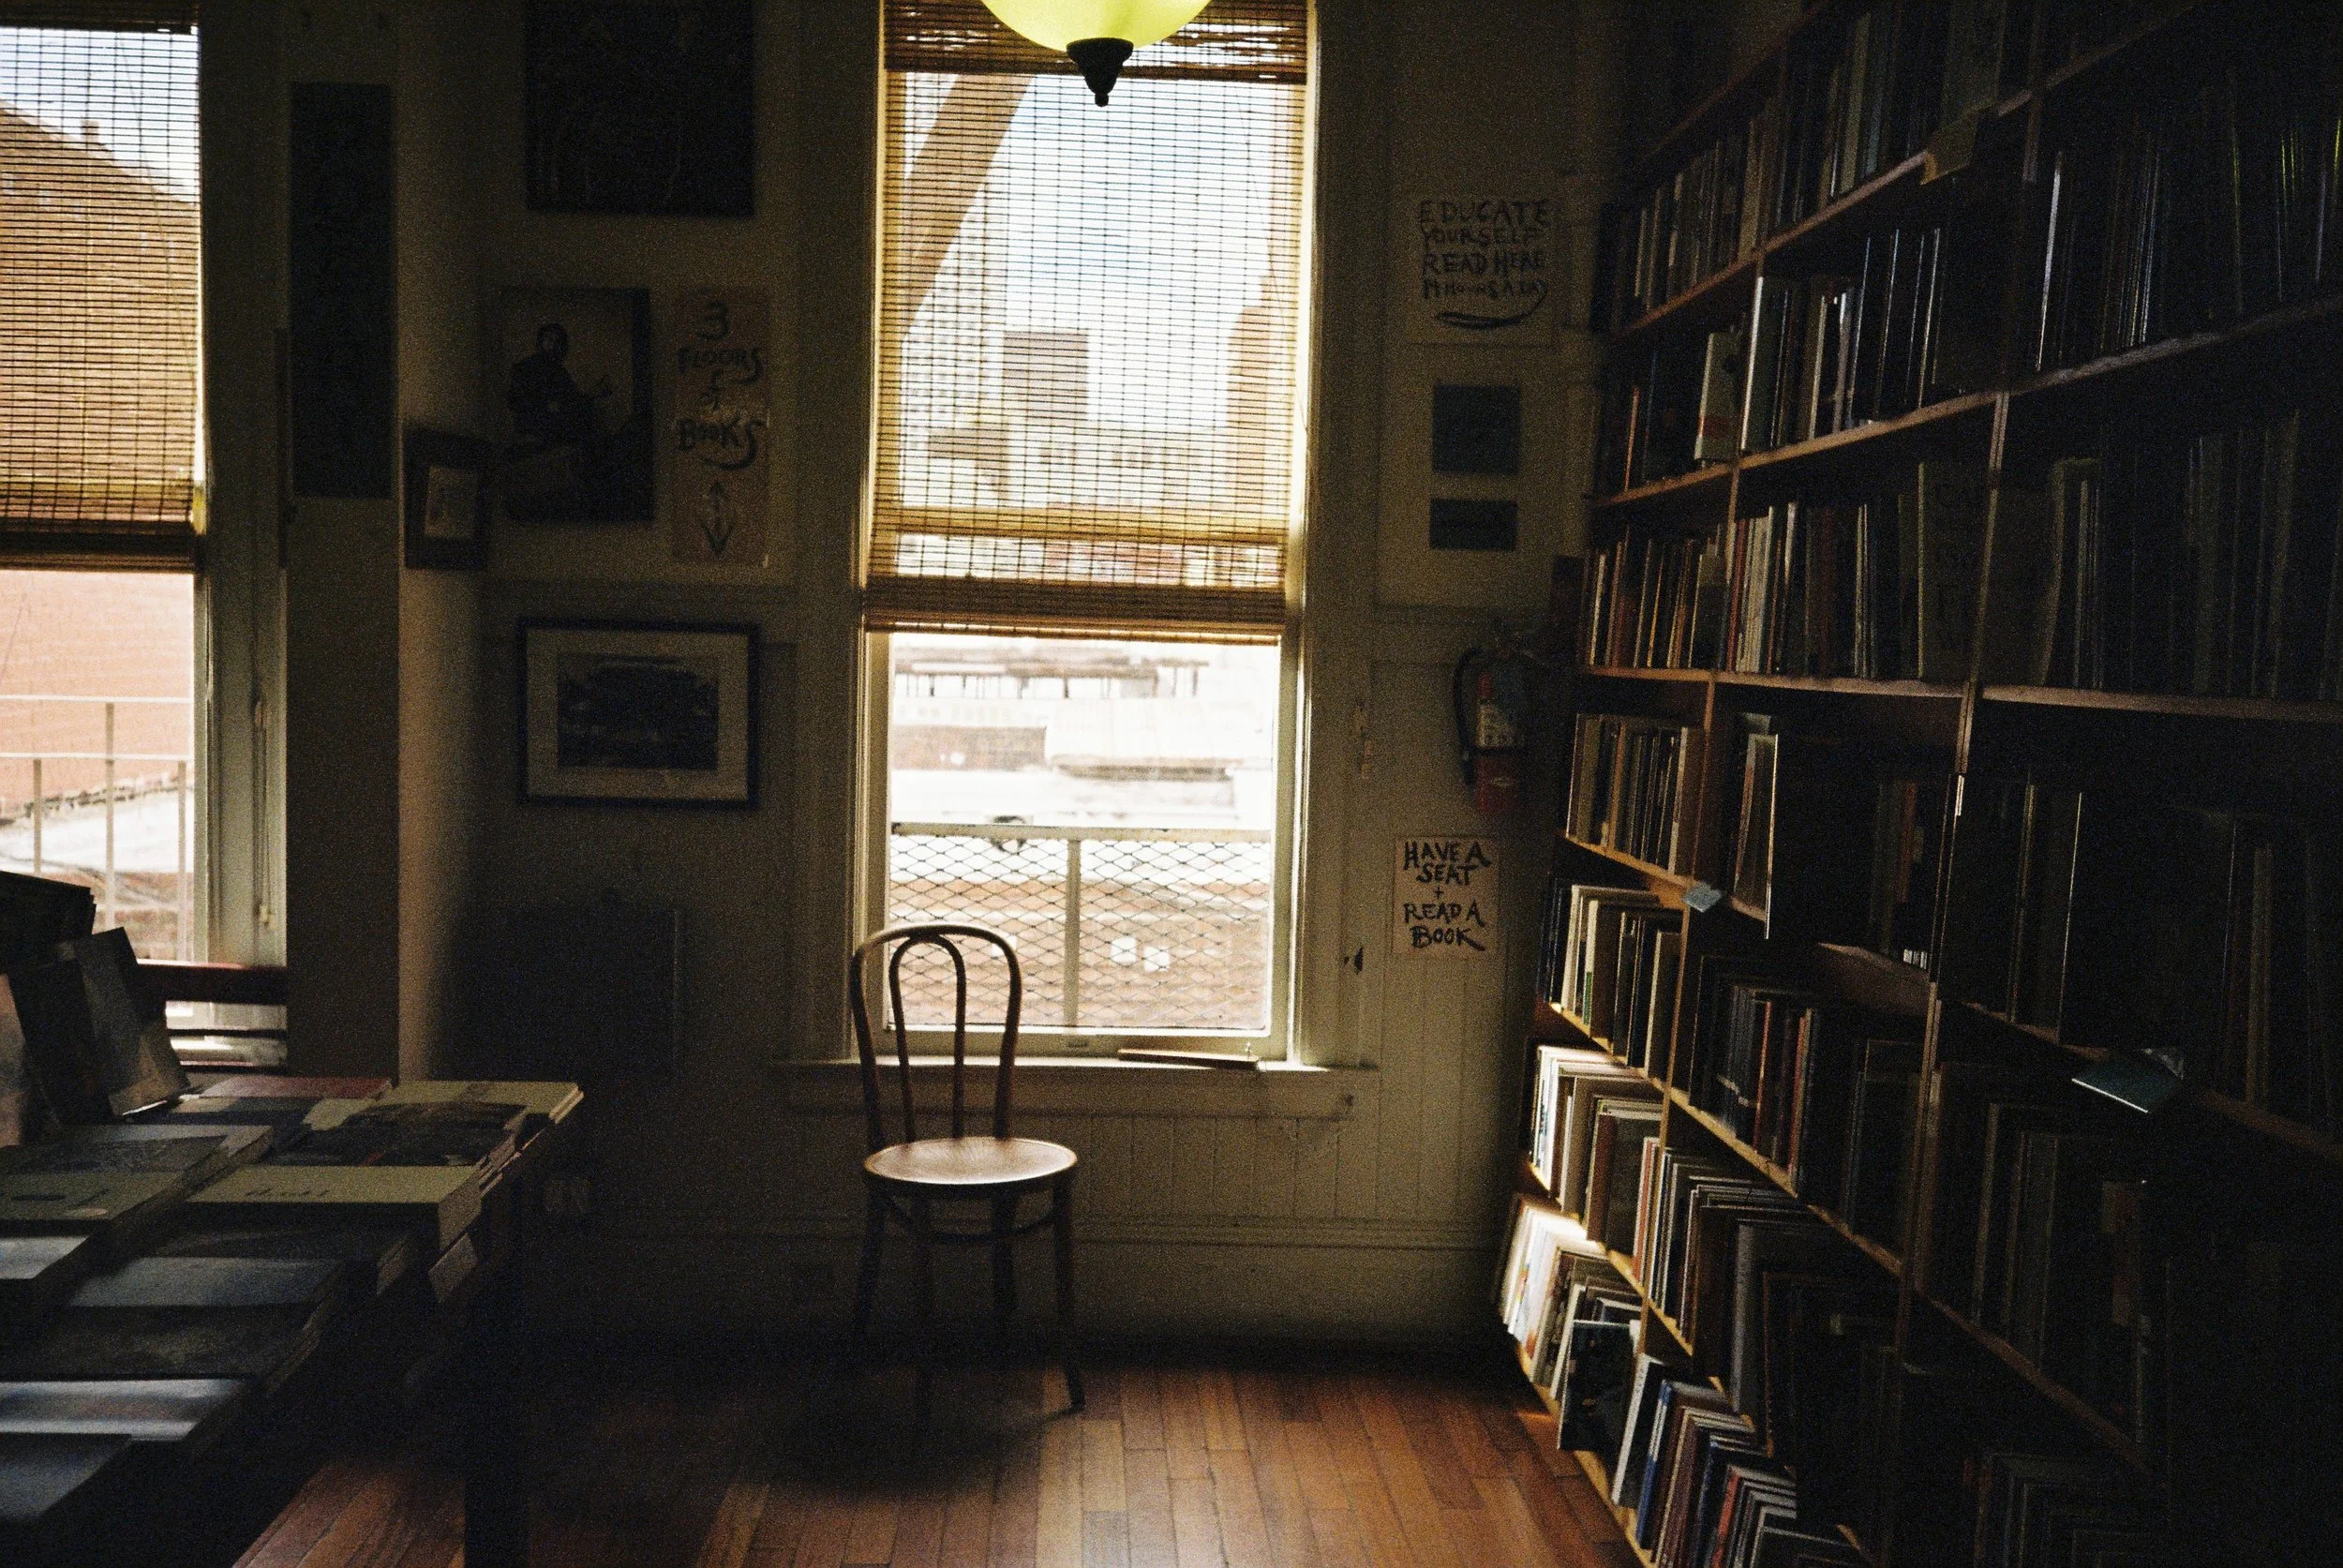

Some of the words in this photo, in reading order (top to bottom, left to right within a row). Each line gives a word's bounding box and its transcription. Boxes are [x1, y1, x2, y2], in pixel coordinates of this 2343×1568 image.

[1418, 198, 1549, 226] EDUCATE
[1419, 225, 1545, 251] YOURSELF
[1421, 252, 1488, 276] READ
[1492, 247, 1546, 276] HERE
[696, 300, 729, 341] 3
[678, 346, 764, 385] FLOORS
[678, 416, 766, 470] BOOKS
[1403, 841, 1460, 871] HAVE
[1464, 841, 1492, 868] A
[1415, 861, 1479, 887] SEAT
[1402, 901, 1463, 924] READ
[1464, 898, 1485, 928] A
[1409, 925, 1486, 952] BOOK
